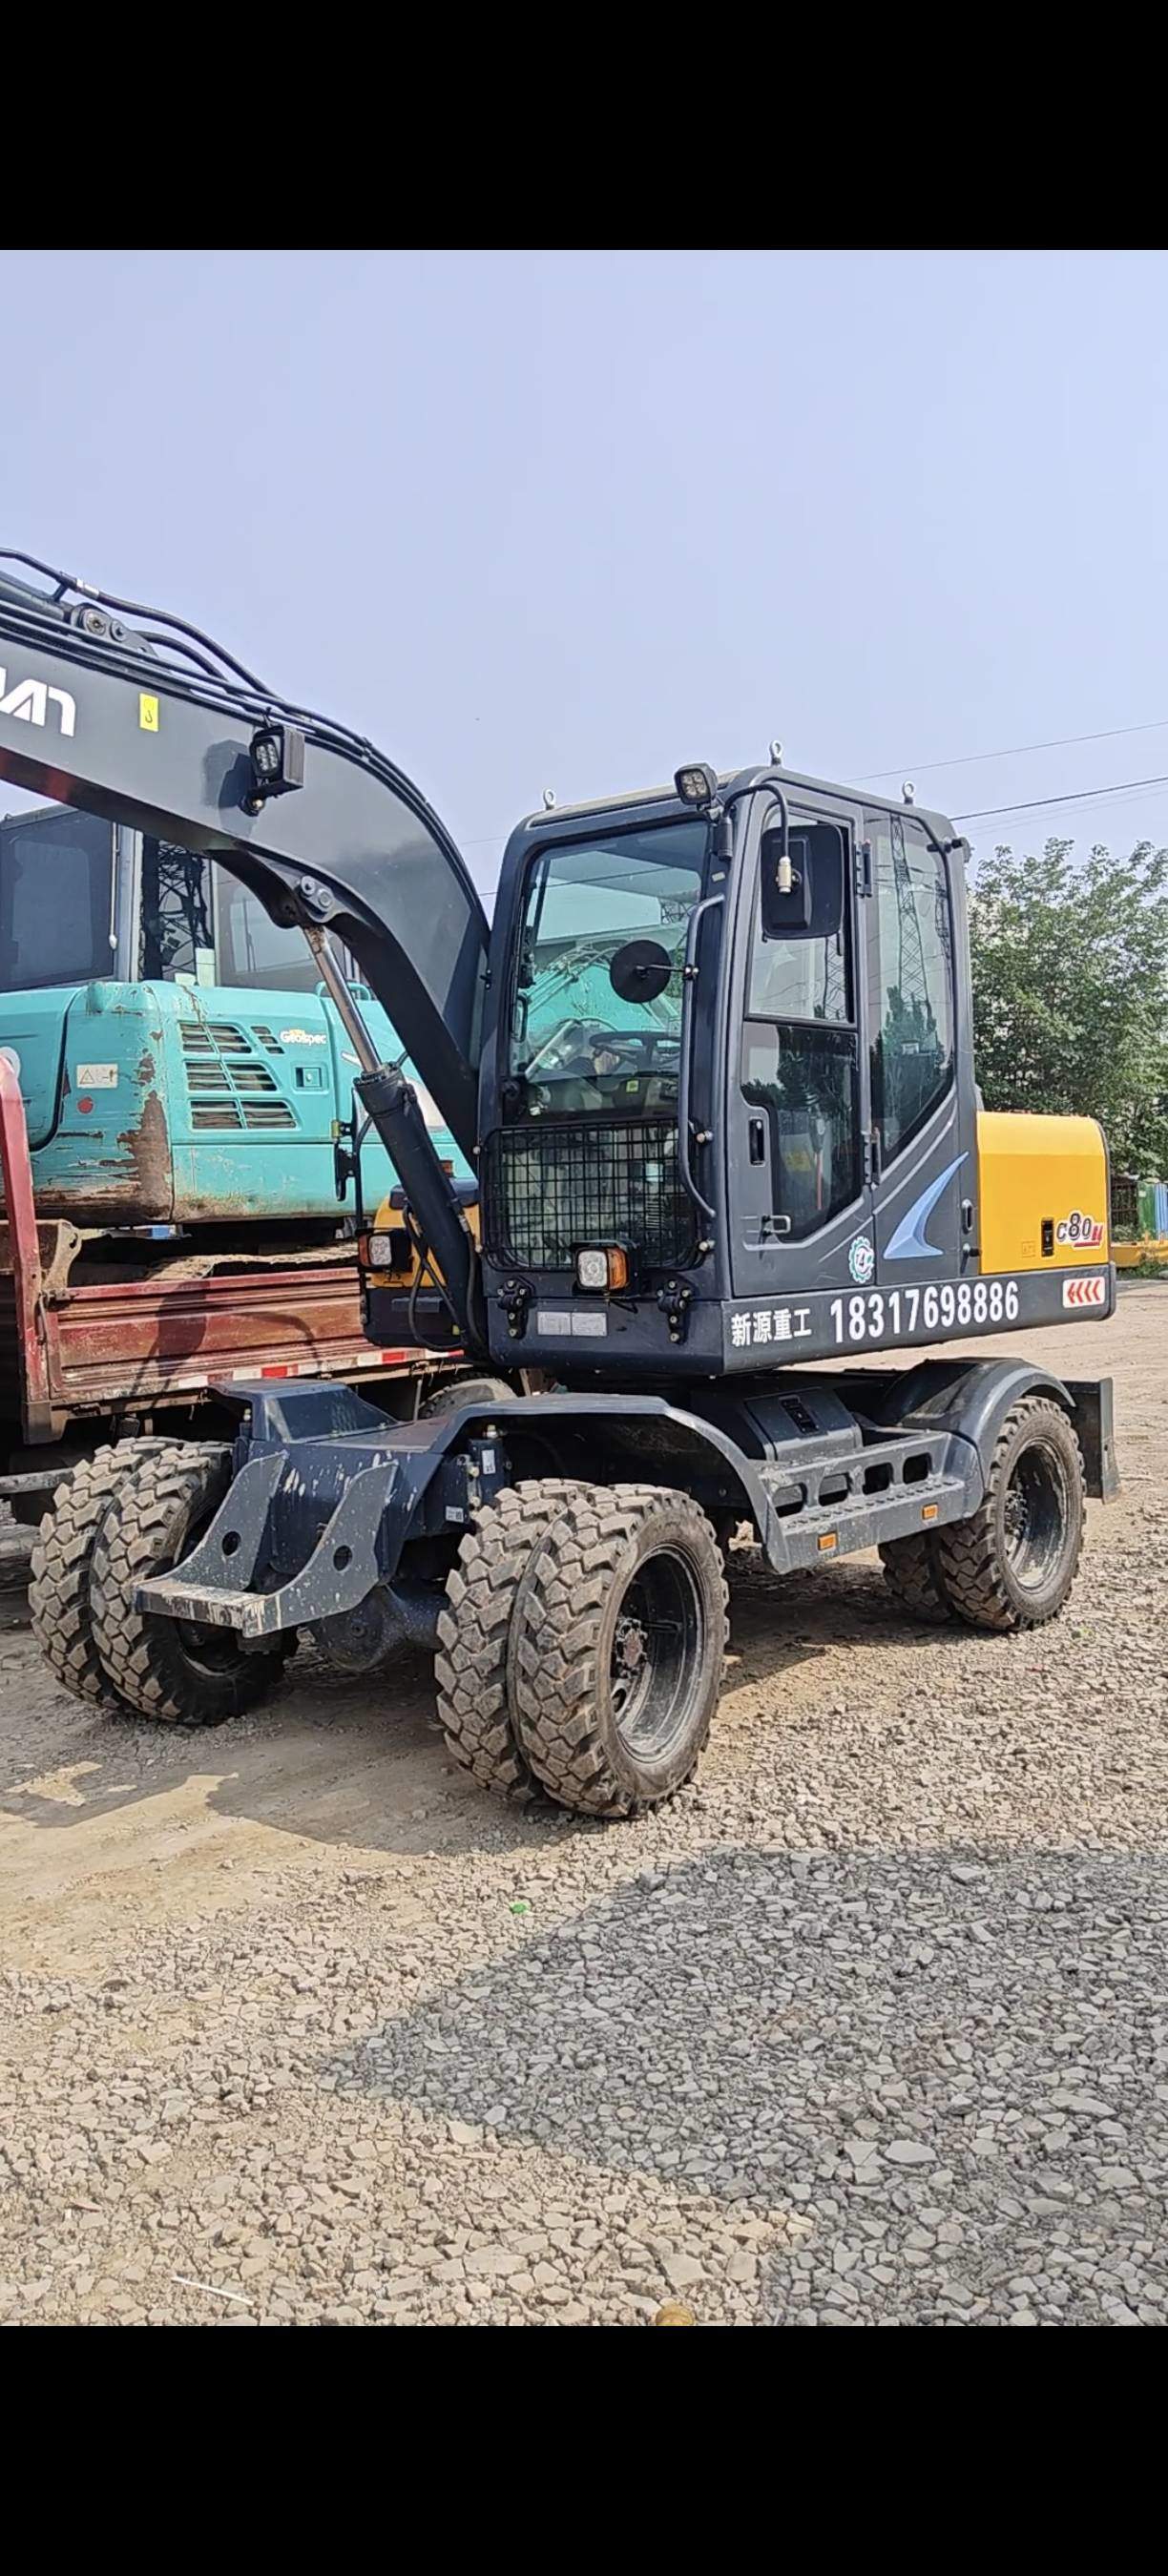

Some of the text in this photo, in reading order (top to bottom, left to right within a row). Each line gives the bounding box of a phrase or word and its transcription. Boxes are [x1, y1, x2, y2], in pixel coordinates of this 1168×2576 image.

[731, 1281, 1019, 1346] 新源重工 18317698886
